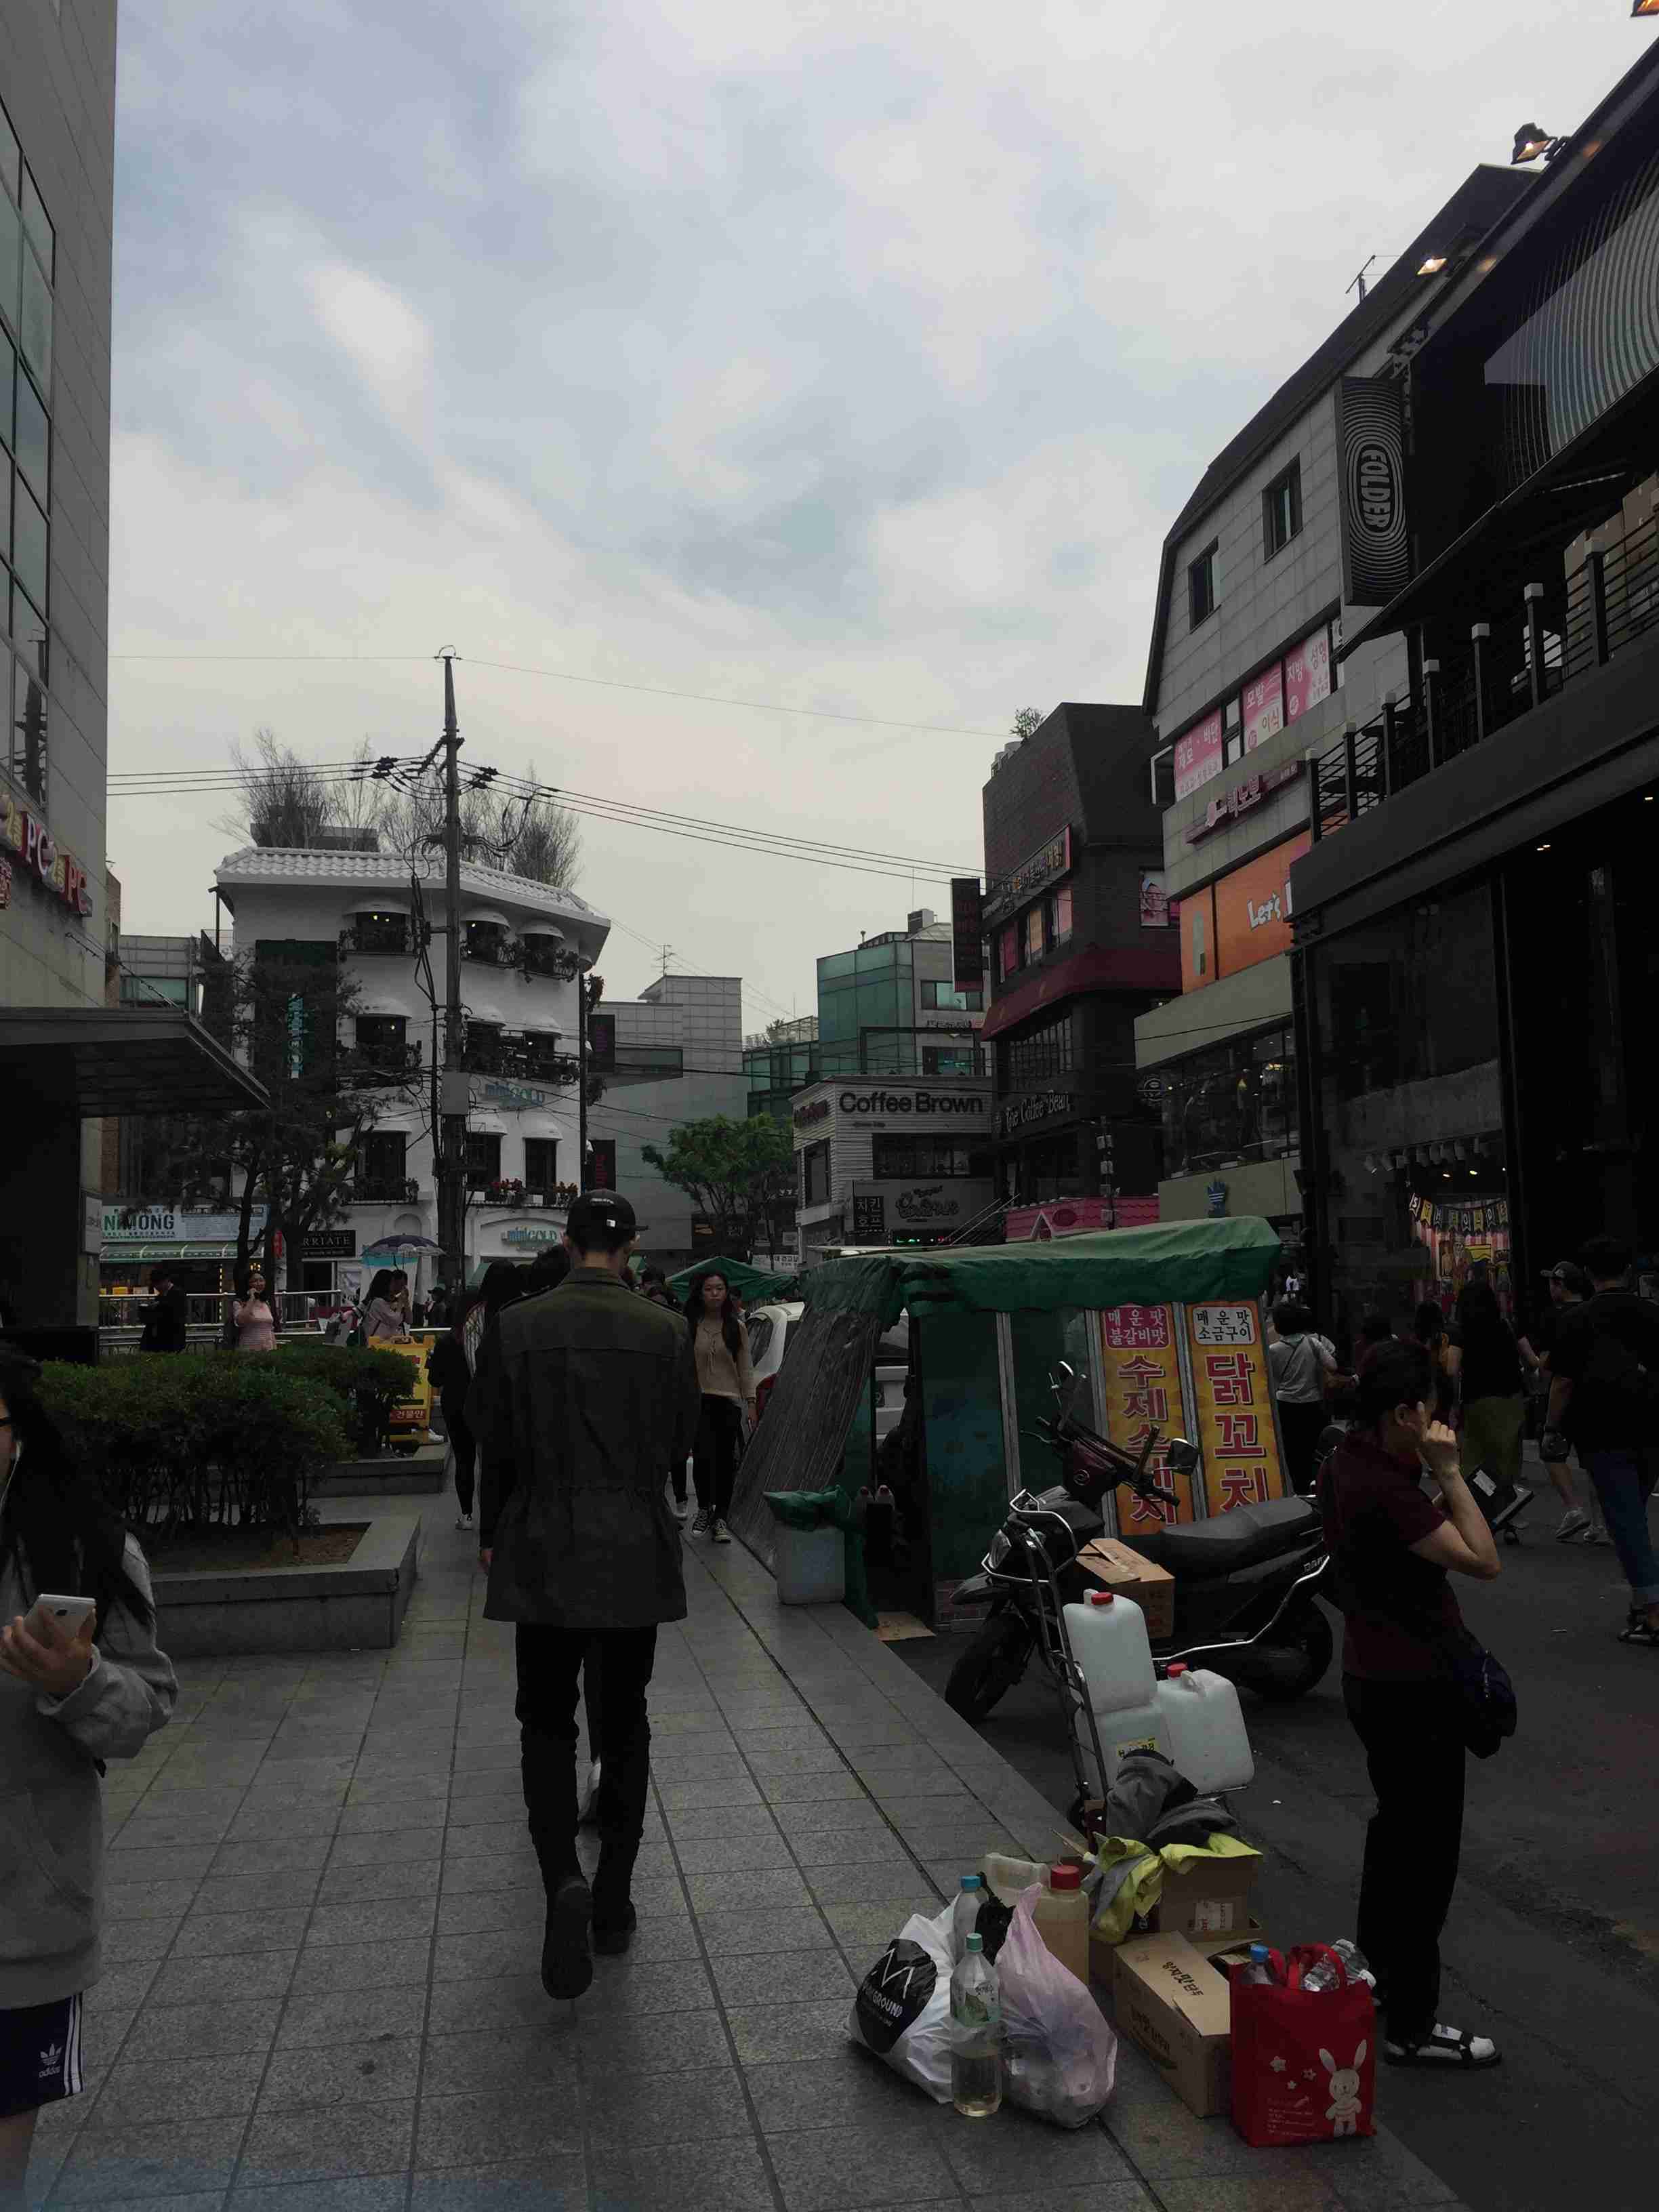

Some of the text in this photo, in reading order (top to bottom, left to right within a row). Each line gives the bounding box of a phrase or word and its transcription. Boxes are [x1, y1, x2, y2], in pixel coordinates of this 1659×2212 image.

[1360, 449, 1391, 528] FOLDER
[1246, 682, 1265, 710] 모발
[840, 1092, 912, 1113] Coffee
[916, 1092, 983, 1113] Brown
[1109, 1327, 1167, 1346] 불갈비맛
[1198, 1325, 1252, 1342] 소금구이
[1205, 1351, 1270, 1513] 닭꼬치
[38, 2065, 60, 2082] adidas
